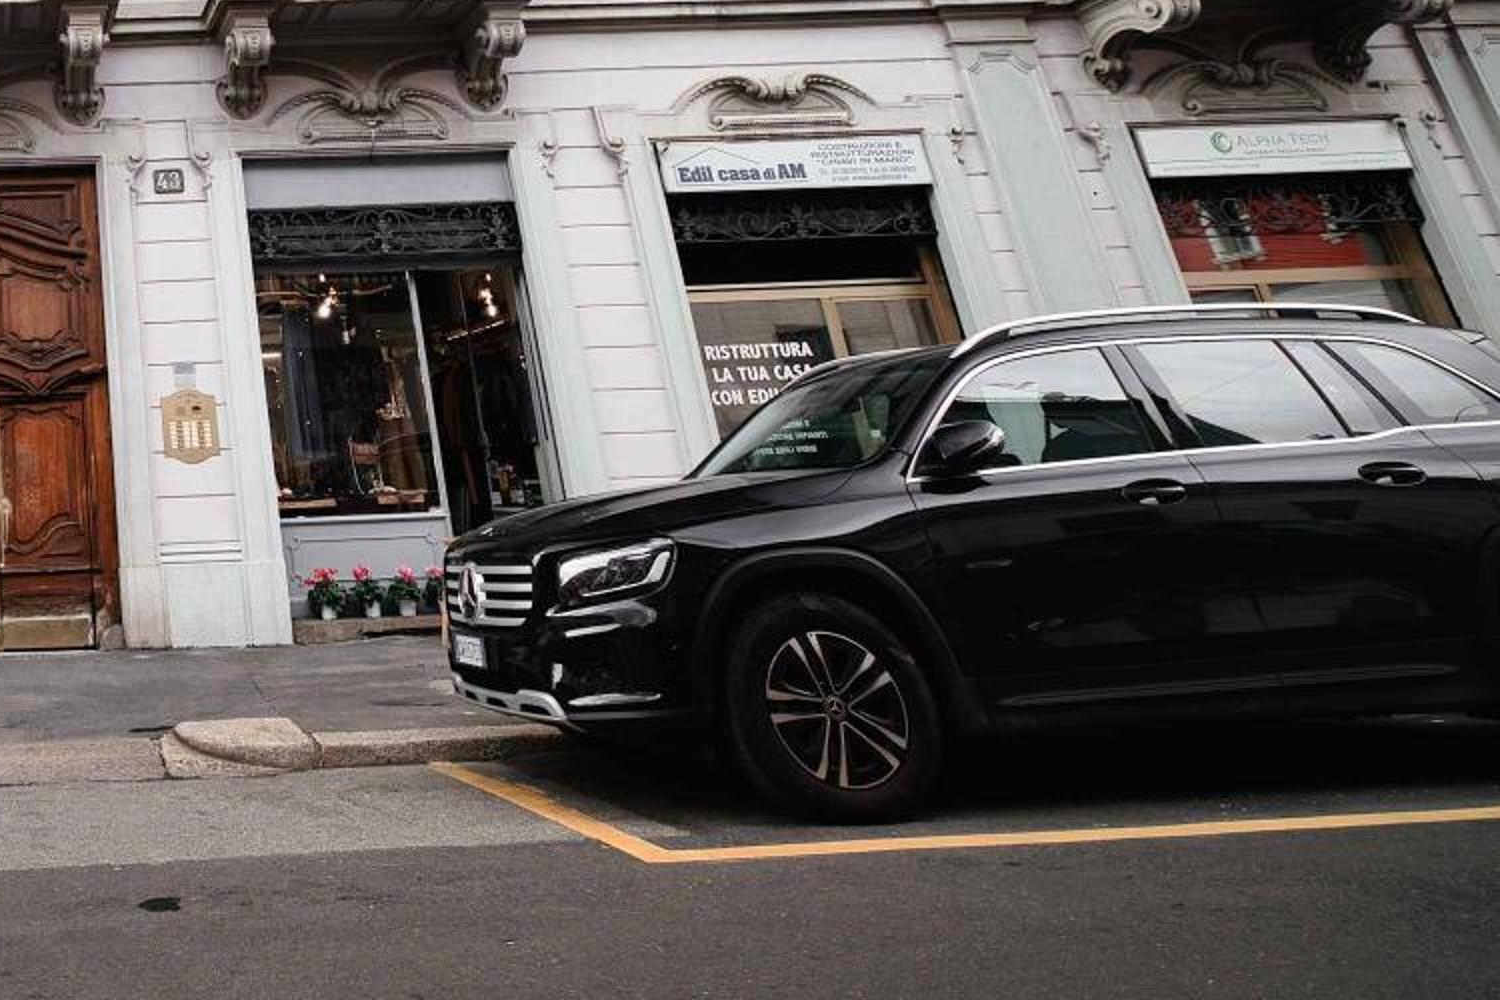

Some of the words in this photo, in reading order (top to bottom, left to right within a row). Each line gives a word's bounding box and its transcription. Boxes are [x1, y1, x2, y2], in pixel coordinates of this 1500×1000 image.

[158, 171, 180, 190] 43
[677, 164, 714, 183] Edil
[717, 167, 761, 181] casa
[763, 167, 776, 180] di
[777, 163, 807, 179] AM
[703, 341, 814, 360] RISTRUTTURA
[711, 366, 734, 383] LA
[737, 365, 770, 382] TUA
[711, 388, 744, 406] CON
